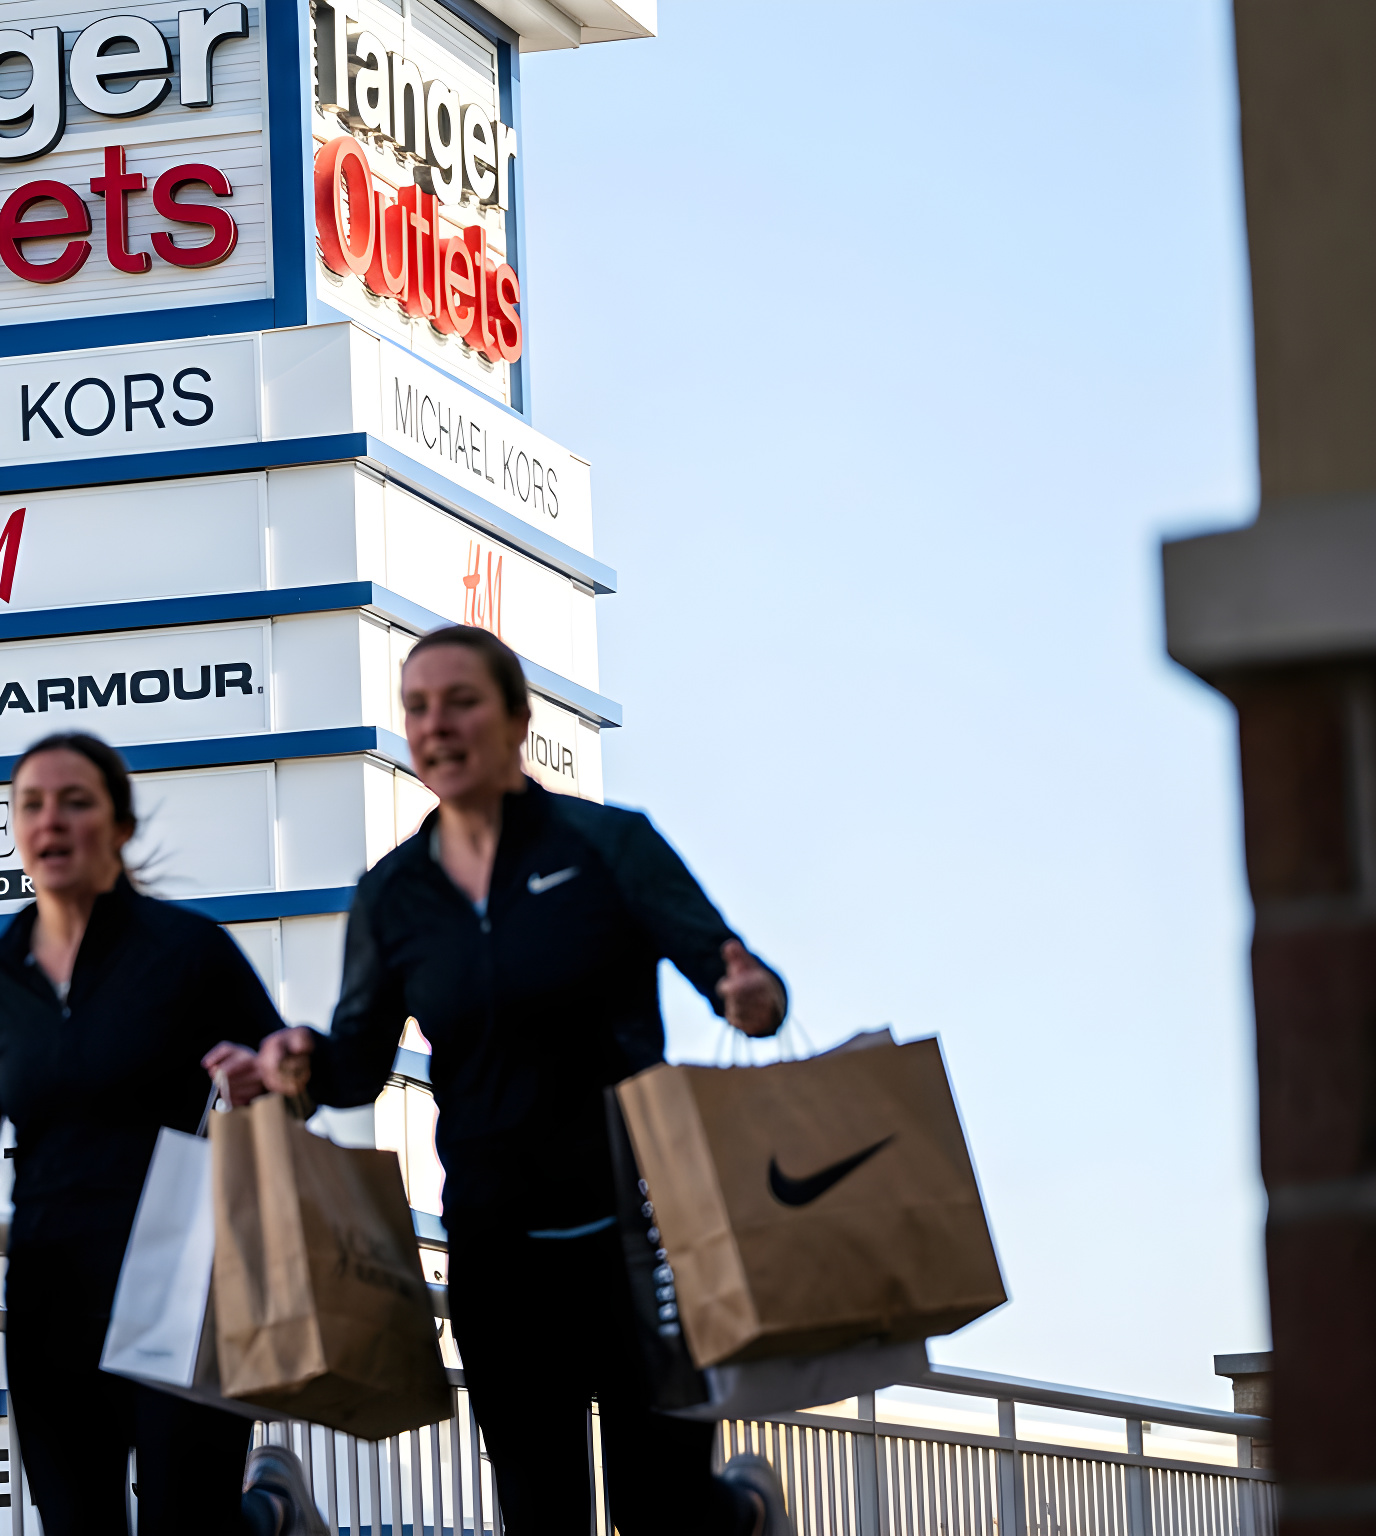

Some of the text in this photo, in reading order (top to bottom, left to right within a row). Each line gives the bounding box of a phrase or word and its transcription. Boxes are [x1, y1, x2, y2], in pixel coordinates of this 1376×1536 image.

[311, 0, 517, 210] Tanger
[314, 136, 522, 363] Outlets
[21, 367, 214, 443] KORS
[394, 376, 559, 519] MICHAEL KORS
